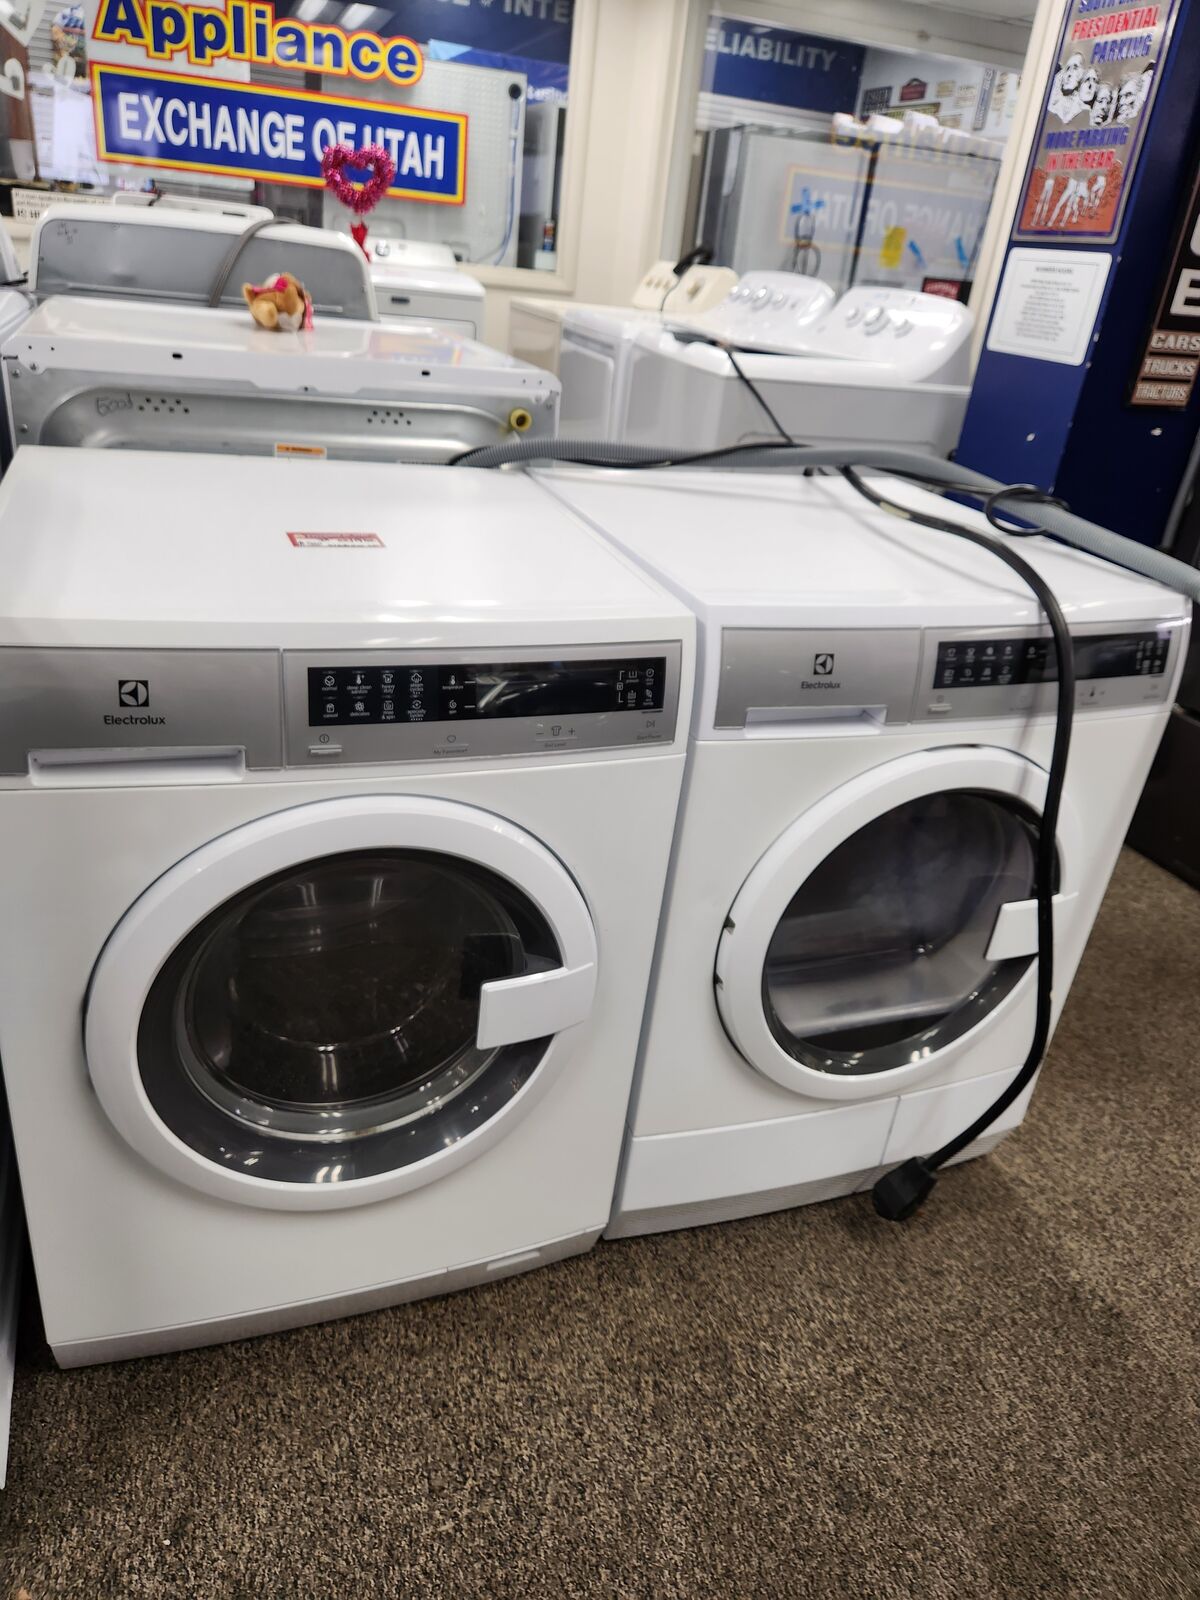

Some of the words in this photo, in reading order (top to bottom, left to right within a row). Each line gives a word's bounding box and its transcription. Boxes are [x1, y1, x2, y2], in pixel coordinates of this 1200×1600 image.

[1071, 5, 1159, 41] PRESIDENTIAL
[96, 0, 422, 82] Appliance
[1091, 32, 1153, 64] PARKING
[117, 91, 305, 161] EXCHANGE
[312, 117, 357, 163] OF
[363, 125, 445, 180] UTAH
[1045, 131, 1076, 149] MORE
[1077, 127, 1129, 148] PARKING
[1060, 151, 1082, 170] THE
[1083, 149, 1116, 170] REAR
[1151, 333, 1200, 352] CARS
[1144, 358, 1197, 377] TRUCKS
[801, 681, 840, 689] Electrolux
[104, 715, 166, 725] Electrolux
